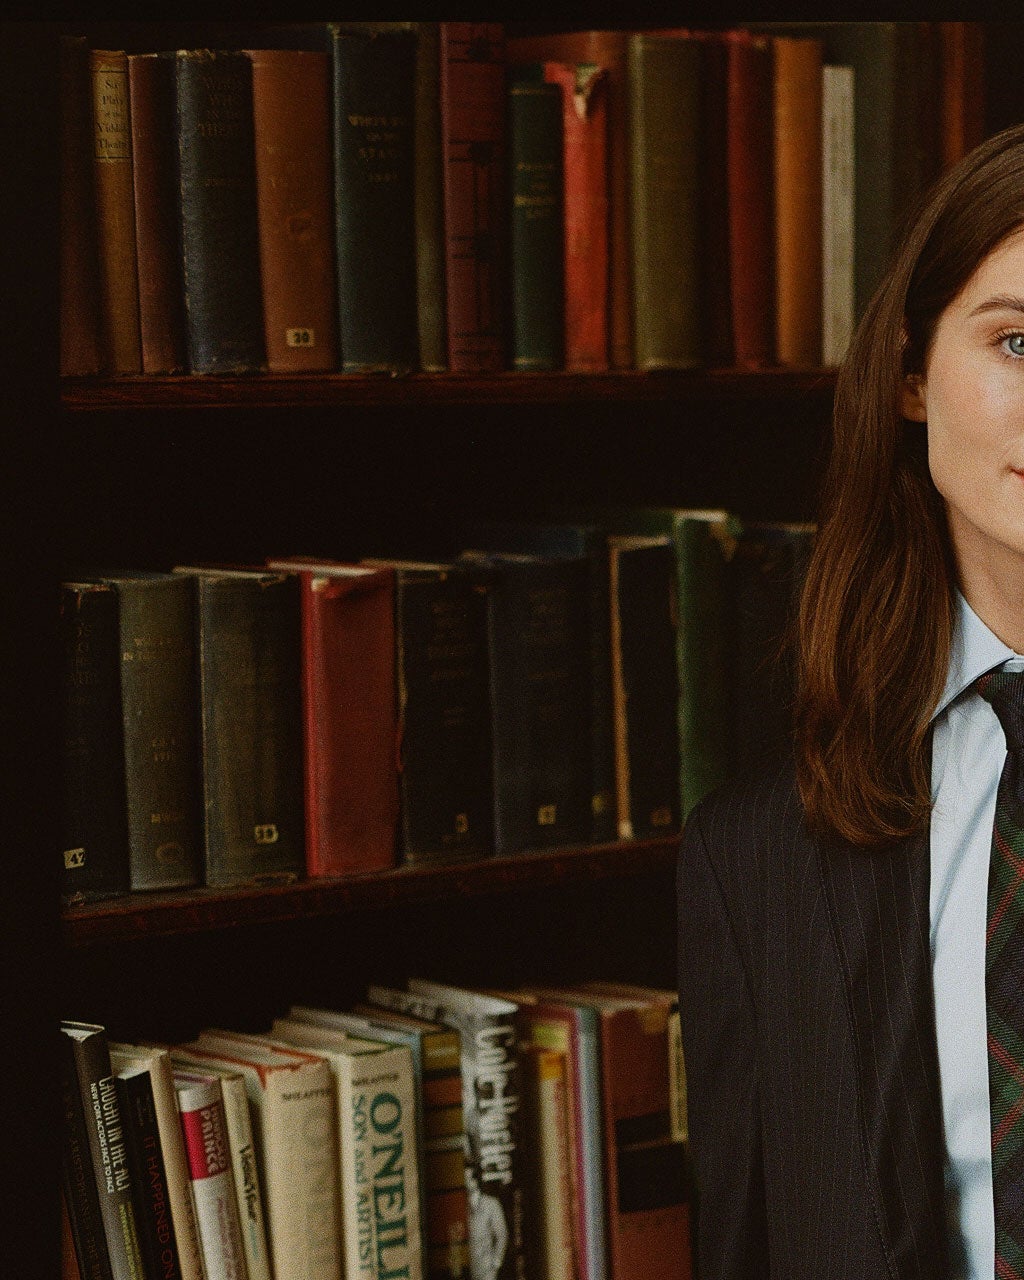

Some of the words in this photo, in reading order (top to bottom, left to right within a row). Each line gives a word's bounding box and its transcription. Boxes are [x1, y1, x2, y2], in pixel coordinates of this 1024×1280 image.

[90, 1082, 99, 1100] NEW
[98, 1075, 120, 1126] CAUGHT
[93, 1100, 103, 1120] YORK
[352, 1092, 367, 1142] SON
[97, 1120, 108, 1149] ACTORS
[107, 1126, 124, 1143] IN
[143, 1135, 156, 1151] IT
[200, 1109, 220, 1175] PRINCE
[101, 1149, 110, 1167] FACE
[110, 1143, 128, 1168] THE
[354, 1148, 368, 1185] and
[104, 1166, 112, 1177] TO
[114, 1168, 131, 1192] ACT
[106, 1176, 115, 1194] FACE
[147, 1155, 170, 1244] HAPPENED
[356, 1191, 374, 1271] ARTIST
[161, 1249, 175, 1279] ON
